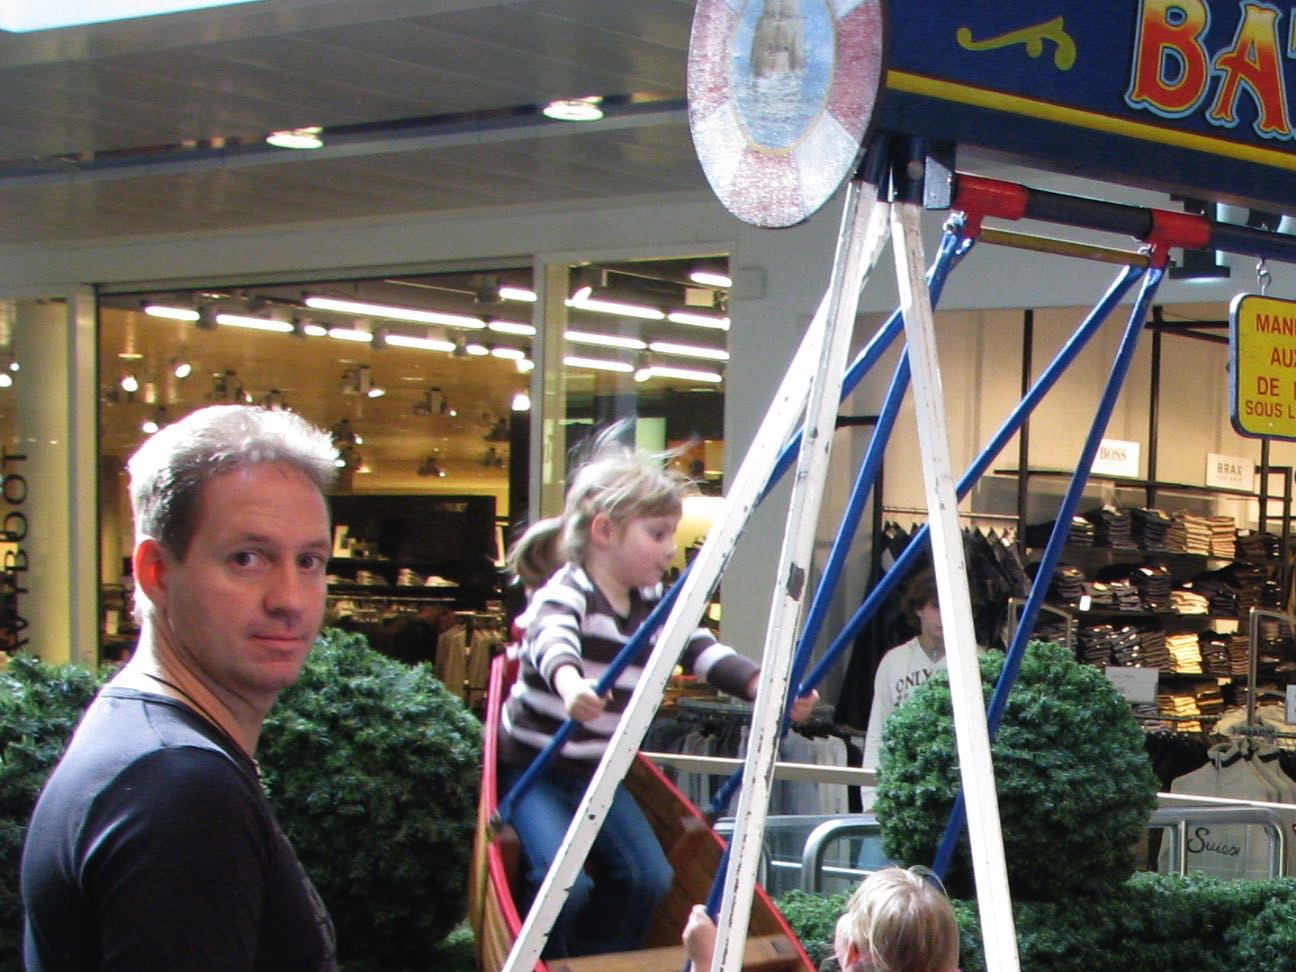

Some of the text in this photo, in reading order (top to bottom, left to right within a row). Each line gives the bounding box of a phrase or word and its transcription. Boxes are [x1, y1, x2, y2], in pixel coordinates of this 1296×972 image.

[1257, 376, 1280, 396] DE
[1245, 400, 1282, 418] SOUS
[1100, 447, 1127, 462] BOSS
[1217, 462, 1242, 476] BRAX
